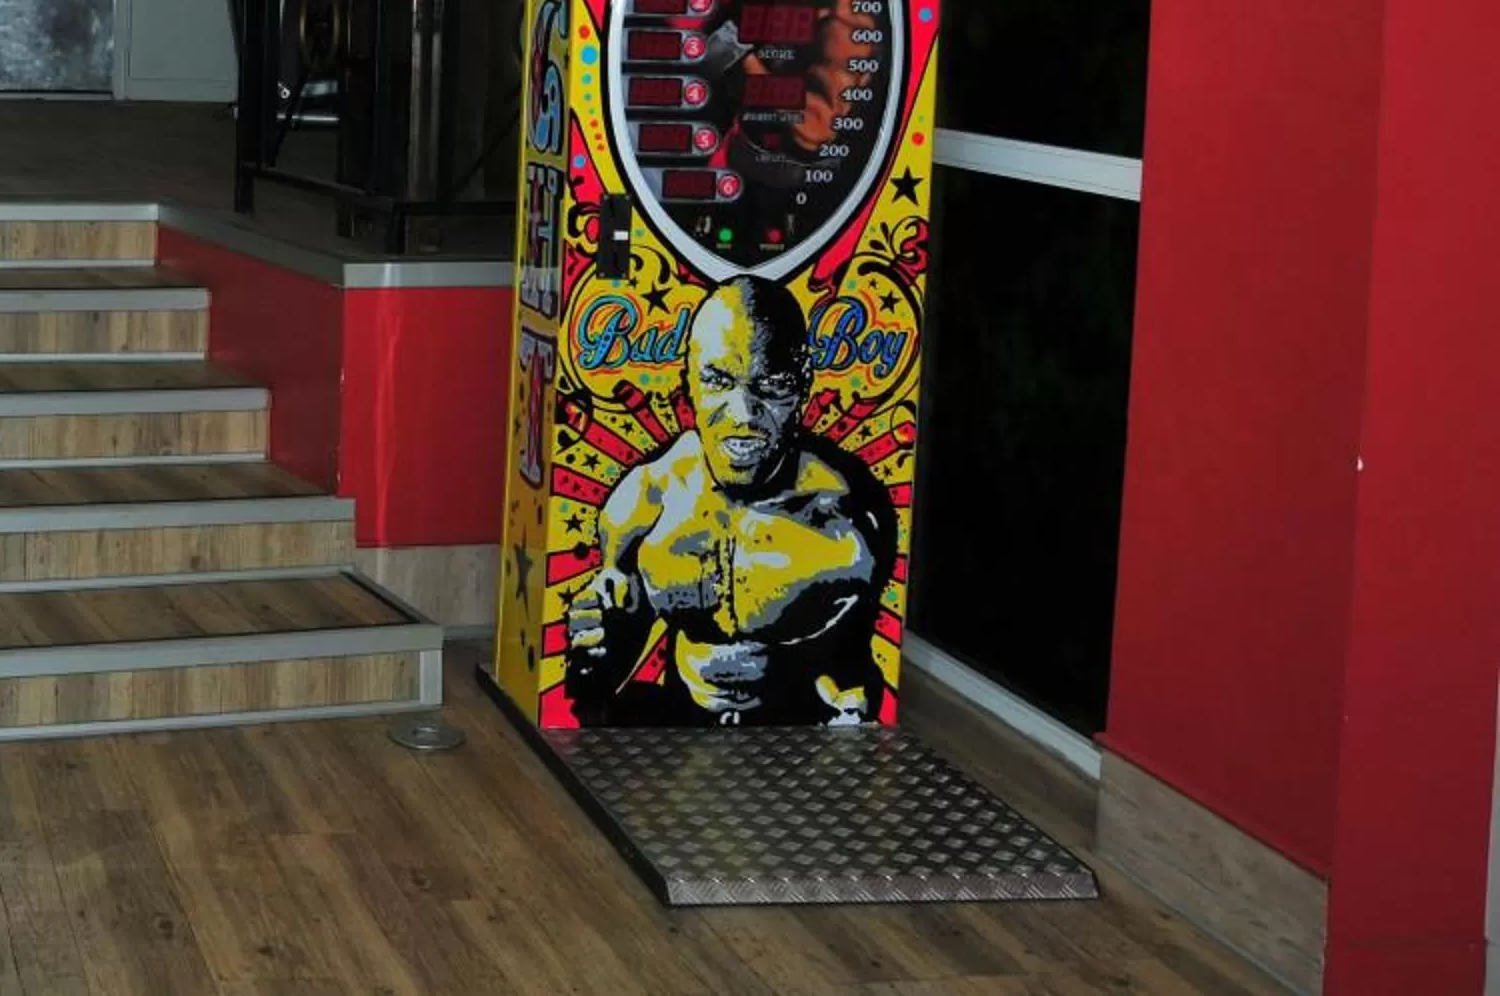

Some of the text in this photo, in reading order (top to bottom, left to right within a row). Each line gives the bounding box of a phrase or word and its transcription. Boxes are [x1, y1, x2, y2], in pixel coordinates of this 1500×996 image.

[852, 1, 882, 14] 700
[852, 30, 883, 43] 600
[849, 60, 879, 73] 500
[841, 89, 873, 102] 400
[834, 118, 864, 131] 300
[819, 145, 849, 157] 200
[805, 170, 833, 183] 100
[796, 193, 807, 205] 0
[806, 295, 909, 380] Boy
